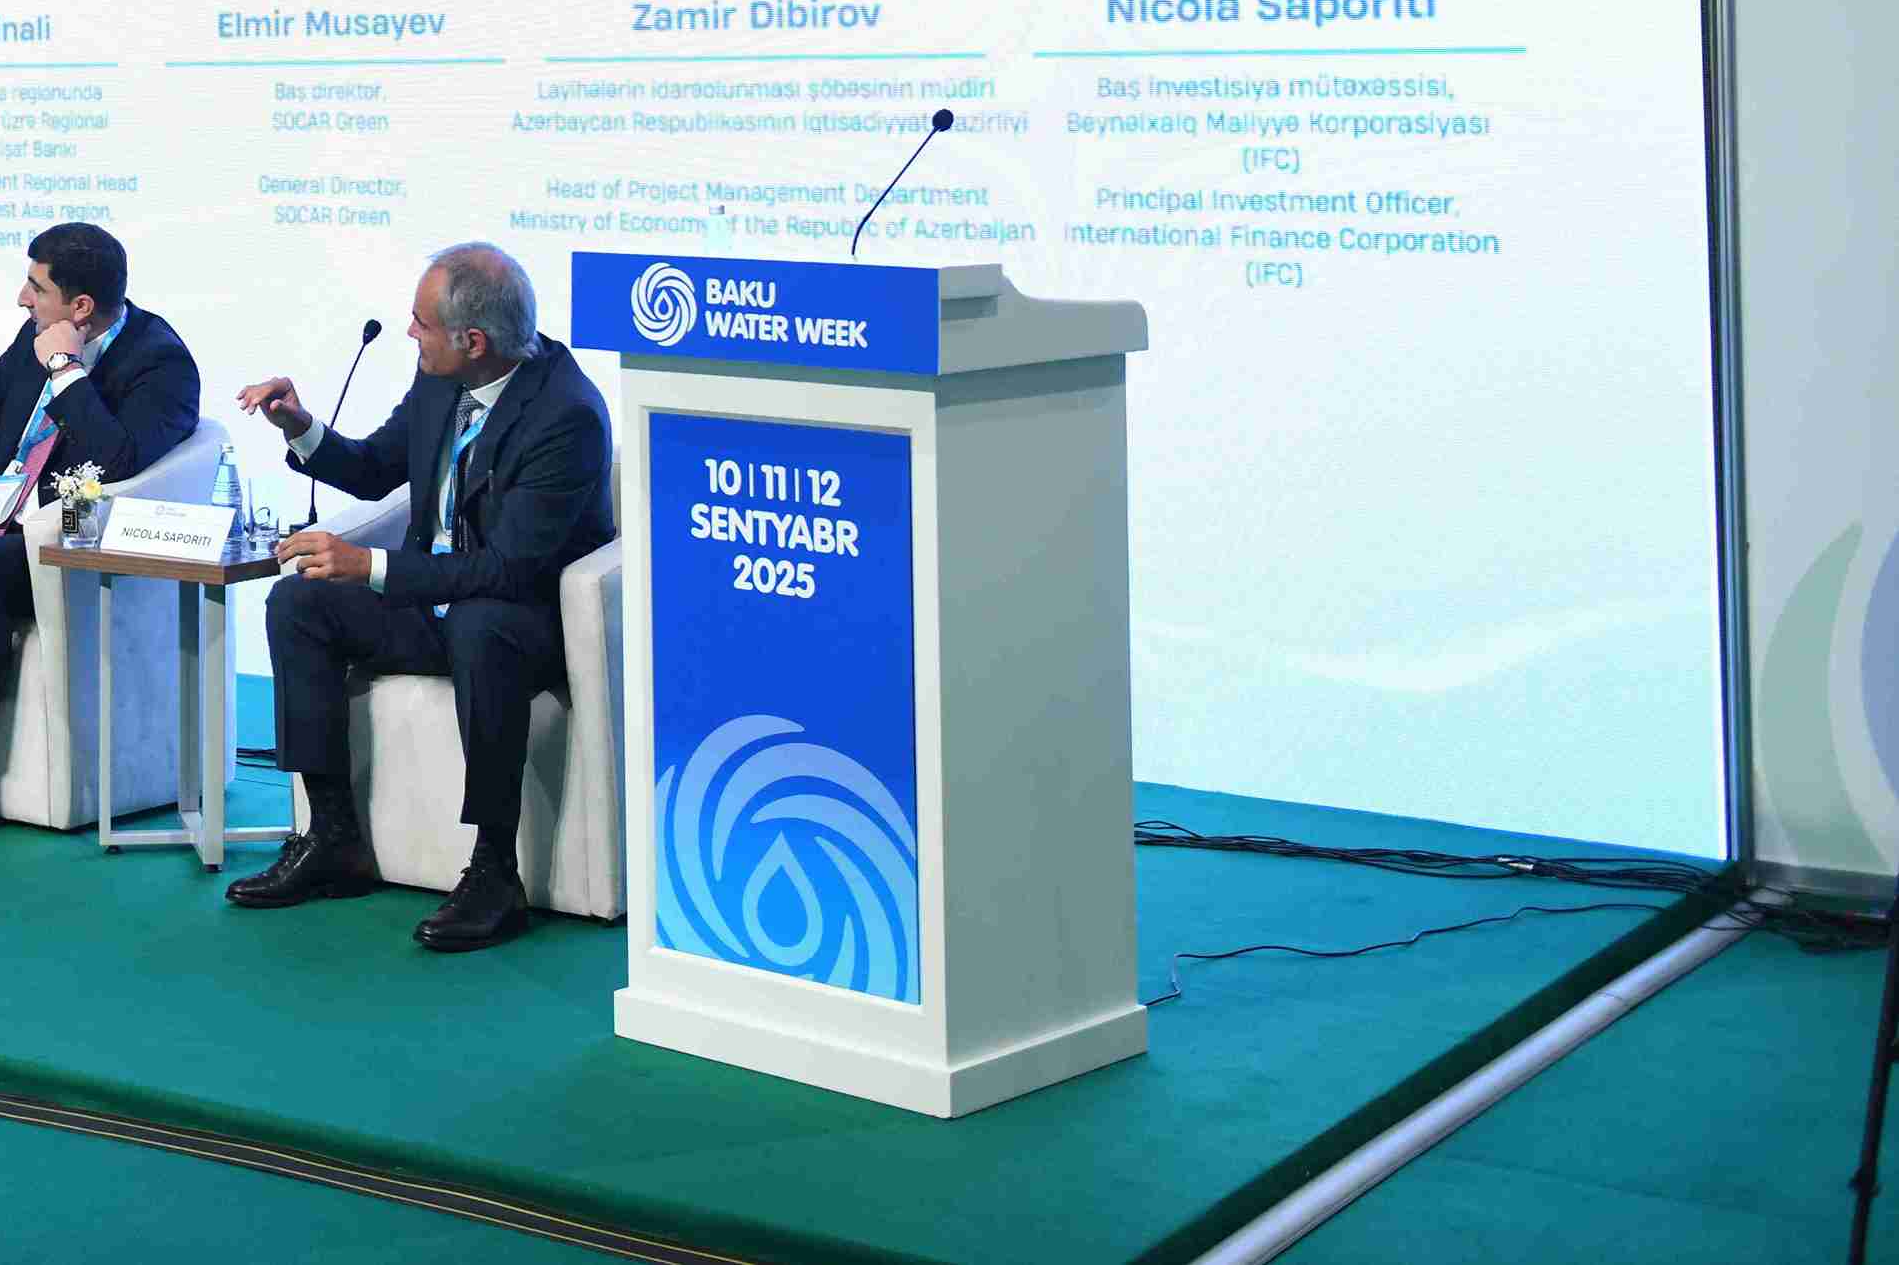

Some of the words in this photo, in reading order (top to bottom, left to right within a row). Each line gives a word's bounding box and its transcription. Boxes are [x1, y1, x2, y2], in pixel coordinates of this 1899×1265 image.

[217, 9, 295, 39] Elmir
[305, 11, 446, 41] Musayev
[630, 0, 738, 31] Zamir
[272, 111, 331, 131] SOCAR
[335, 111, 390, 131] Green
[258, 175, 326, 195] General
[546, 181, 597, 199] Head
[629, 180, 699, 204] Project
[705, 182, 847, 207] Management
[1095, 187, 1203, 214] Principal
[1213, 189, 1357, 214] Investment
[274, 206, 333, 225] SOCAR
[338, 207, 390, 226] Green
[510, 212, 586, 234] Ministry
[1064, 224, 1221, 247] International
[1230, 225, 1331, 250] Finance
[1339, 227, 1501, 256] Corporation
[705, 278, 777, 308] BAKU
[705, 310, 788, 343] WATER
[795, 316, 868, 349] WEEK
[122, 526, 161, 540] NICOLA
[162, 530, 212, 547] SAPORITI
[690, 503, 860, 558] SENTYABR
[733, 553, 817, 599] 2025
